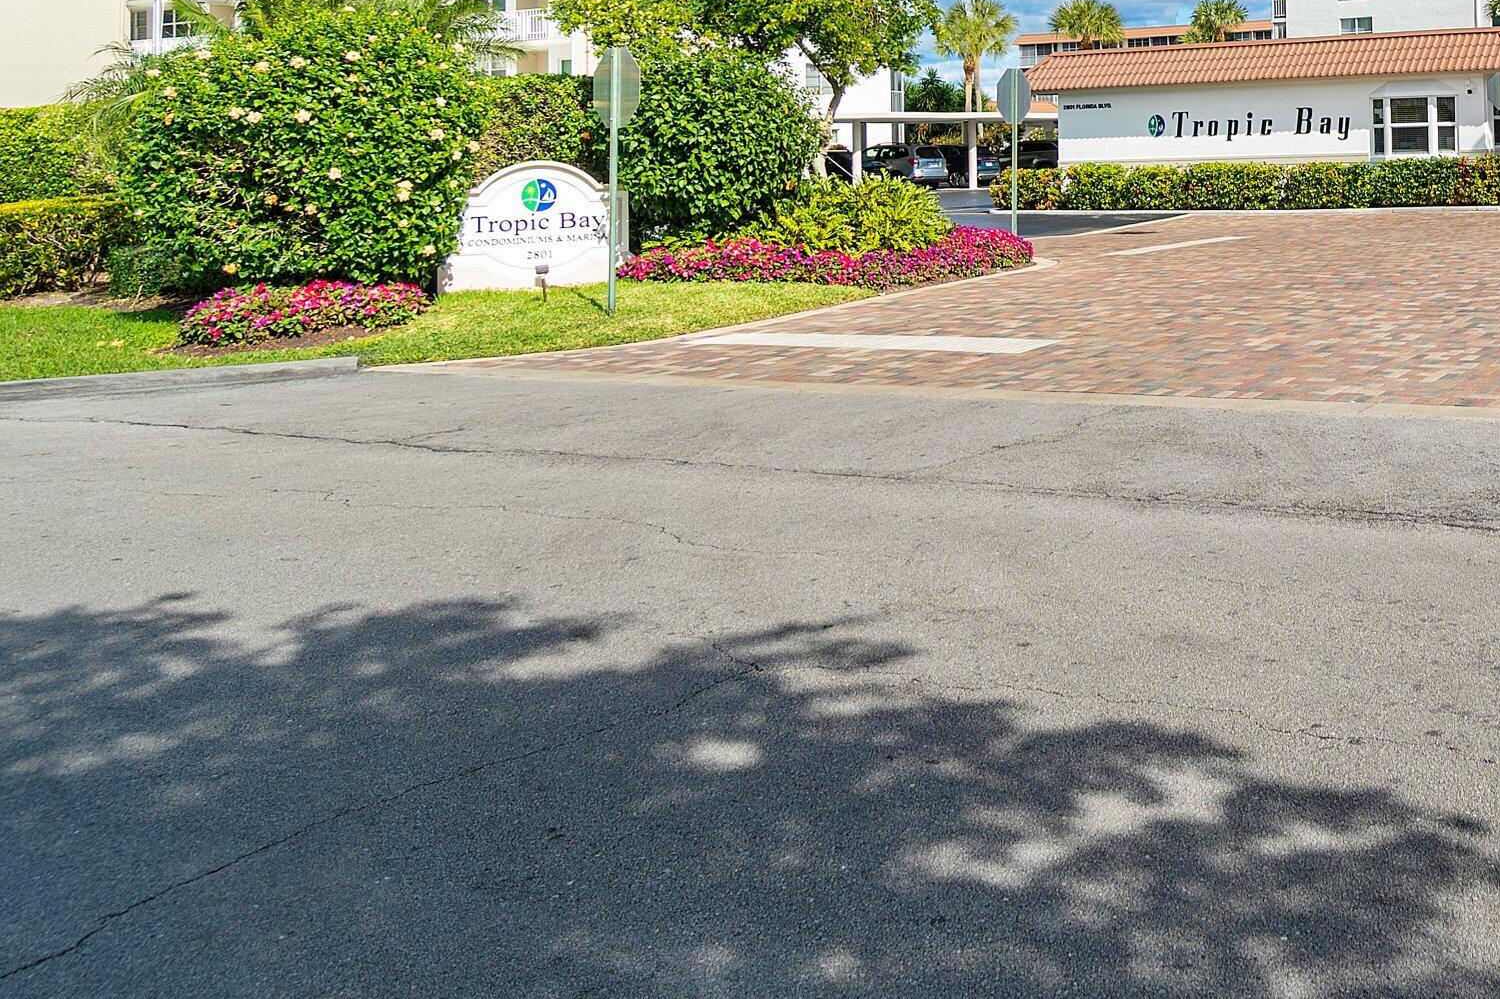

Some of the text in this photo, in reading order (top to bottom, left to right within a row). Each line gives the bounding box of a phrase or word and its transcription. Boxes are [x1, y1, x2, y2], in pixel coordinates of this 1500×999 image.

[1172, 107, 1351, 141] Tropic Bay
[470, 212, 605, 235] Tropic Bay
[468, 236, 553, 247] CONDOMINIUMS
[527, 251, 552, 259] 2801
